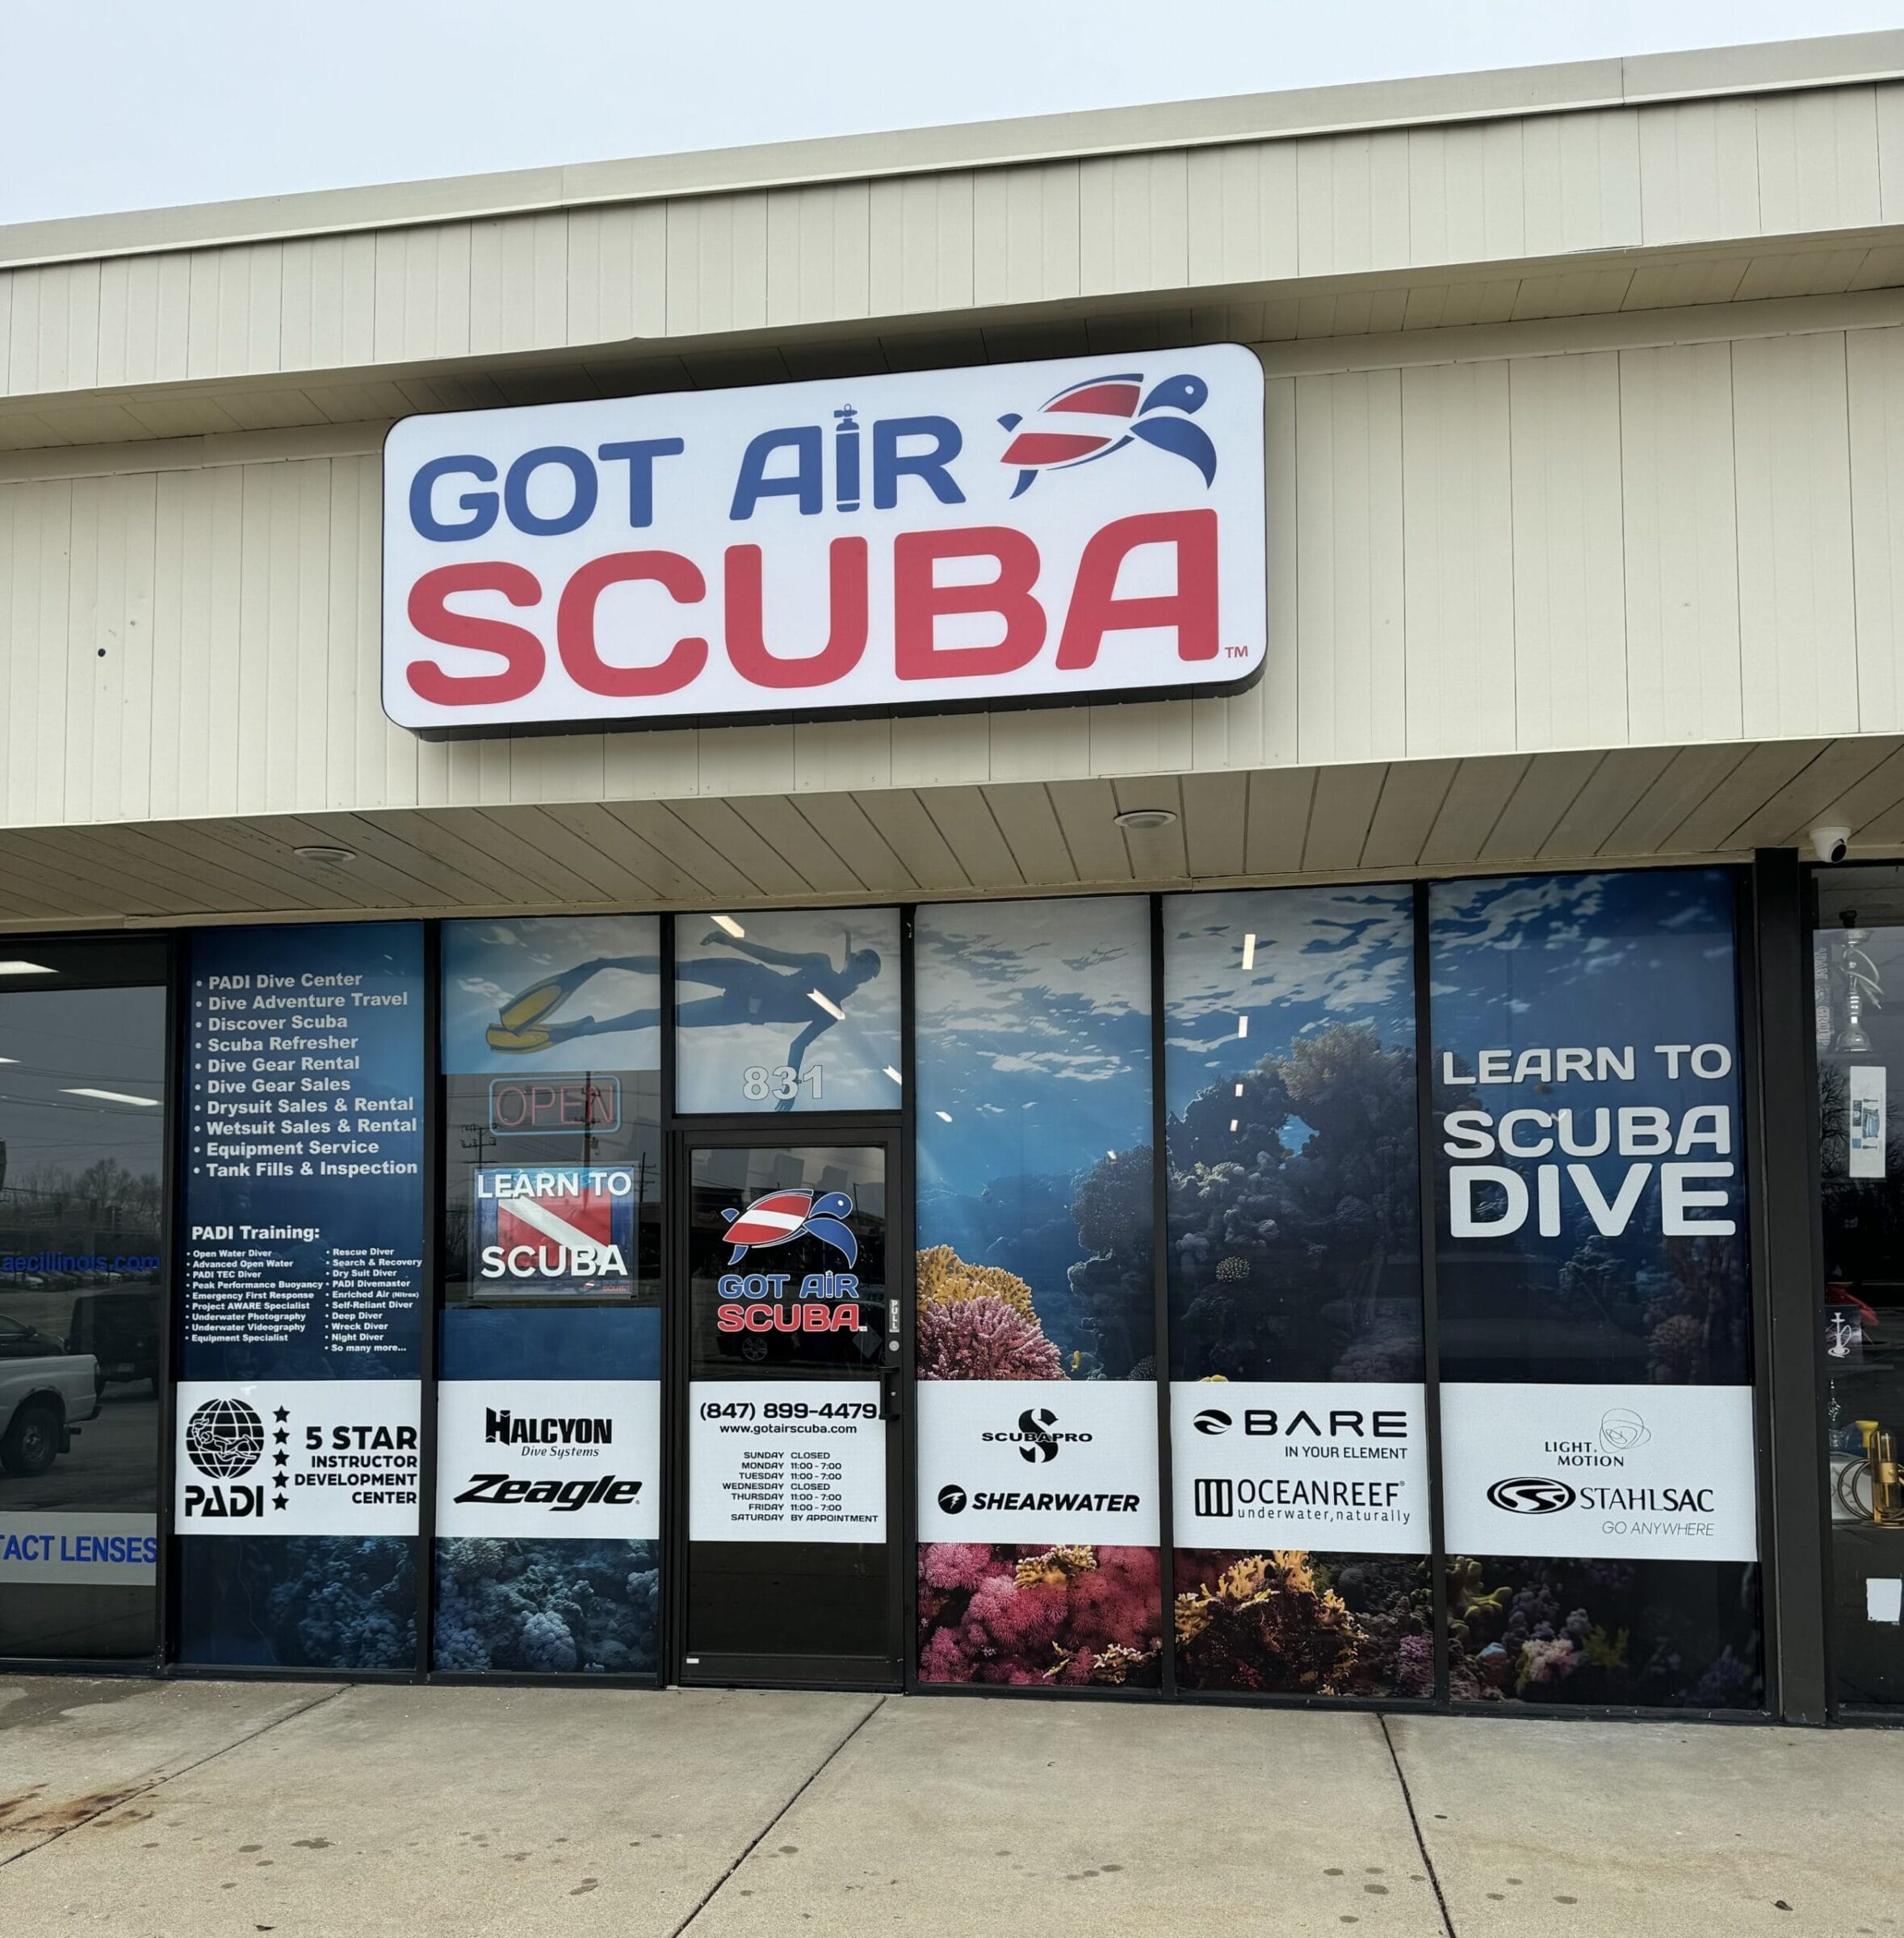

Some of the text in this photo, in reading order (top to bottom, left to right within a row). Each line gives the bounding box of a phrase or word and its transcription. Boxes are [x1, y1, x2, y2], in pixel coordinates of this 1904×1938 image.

[409, 437, 684, 543] GOT
[406, 508, 1218, 707] SCUBA
[1224, 646, 1248, 659] TM
[209, 973, 362, 989] PADI Dive Center
[209, 992, 407, 1010] Dive Adventure Travel
[208, 1015, 347, 1031] Discover Scuba
[208, 1036, 359, 1051] Scuba Refresher
[208, 1056, 359, 1072] Dive Gear Rental
[1443, 1043, 1731, 1084] LEARN TO
[208, 1077, 350, 1093] Dive Gear Sales
[743, 1065, 823, 1100] 831
[208, 1097, 413, 1117] Drysuit Sales & Rental
[496, 1084, 614, 1126] OPEN
[207, 1118, 417, 1135] Wetsuit Sales & Rental
[1443, 1105, 1730, 1159] SCUBA
[207, 1140, 379, 1158] Equipment Service
[207, 1160, 417, 1177] Tank Fills & Inspection
[477, 1172, 631, 1198] LEARN TO
[1449, 1162, 1736, 1238] DIVE
[192, 1226, 320, 1242] PADI Training:
[193, 1251, 216, 1259] Open
[379, 1259, 422, 1267] Recovery
[481, 1244, 627, 1277] SCUBA
[240, 1261, 263, 1269] Open
[333, 1270, 349, 1278] Dry
[279, 1281, 323, 1290] Buoyancy
[718, 1274, 790, 1298] GOT
[192, 1292, 242, 1301] Emergency
[270, 1291, 314, 1300] Response
[192, 1302, 224, 1311] Project
[264, 1302, 310, 1311] Specialist
[332, 1301, 386, 1309] Self-Reliant
[248, 1313, 306, 1321] Photography
[332, 1312, 355, 1320] Deep
[717, 1304, 859, 1332] SCUBA
[248, 1323, 305, 1332] Videography
[192, 1334, 287, 1343] Equipment Specialist
[331, 1333, 356, 1342] Night
[700, 1403, 877, 1420] (847) 899-4479
[485, 1407, 612, 1445] HALCYON
[720, 1424, 857, 1434] www.gotairscuba.com
[1245, 1410, 1407, 1437] BARE
[305, 1426, 417, 1450] 5 STAR
[982, 1433, 1092, 1442] SCUBAPRO
[522, 1446, 599, 1459] Dive Systems
[1285, 1446, 1407, 1458] IN YOUR ELEMENT
[312, 1455, 417, 1468] INSTRUCTOR
[1558, 1456, 1624, 1467] MOTION
[295, 1474, 417, 1486] DEVELOPMENT
[185, 1485, 263, 1517] PADI
[352, 1492, 417, 1504] CENTER
[972, 1493, 1140, 1512] SHEARWATER
[1580, 1487, 1714, 1512] STAHLSAC
[1238, 1507, 1410, 1525] underwater,naturally
[1602, 1521, 1714, 1536] GO ANYWHERE
[61, 1536, 157, 1563] LENSES
